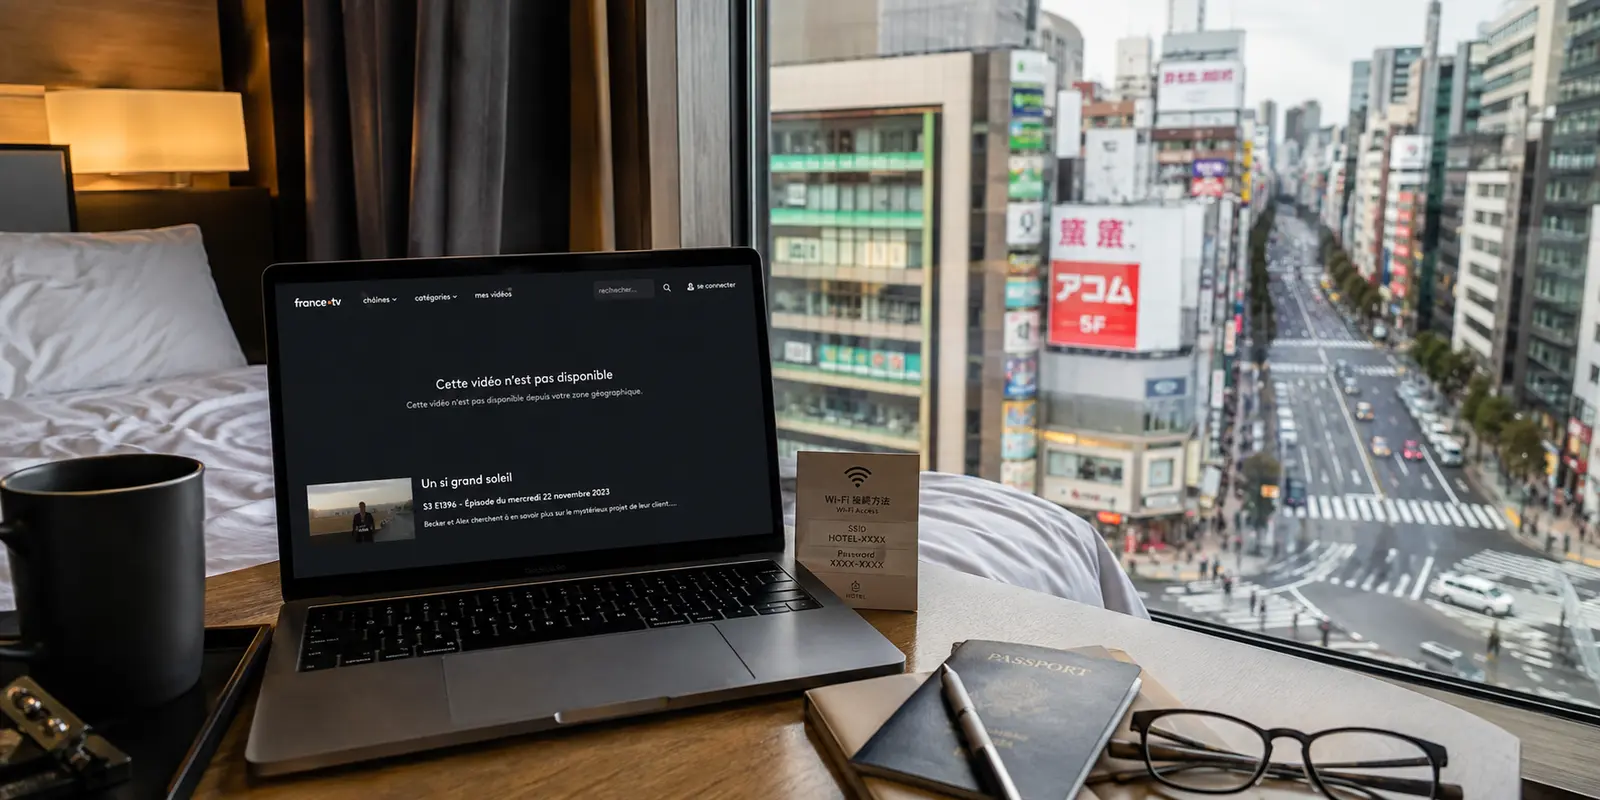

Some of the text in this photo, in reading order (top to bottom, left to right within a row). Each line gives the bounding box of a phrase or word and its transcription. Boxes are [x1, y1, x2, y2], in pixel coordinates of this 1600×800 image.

[1056, 273, 1134, 305] アコム
[1080, 314, 1106, 333] 5F
[436, 369, 613, 390] Cette vidéo n'est pas disponible
[406, 401, 428, 409] Cette
[471, 398, 485, 406] pas
[486, 394, 524, 405] disponible
[526, 392, 550, 402] depuis
[590, 388, 643, 400] géographique.
[421, 472, 512, 489] Un si grand soleil
[422, 502, 433, 510] S3
[434, 501, 457, 510] E1396
[464, 498, 494, 508] Épisode
[496, 496, 506, 504] du
[508, 494, 541, 503] mercredi
[543, 492, 552, 500] 22
[554, 490, 591, 500] novembre
[592, 488, 610, 496] 2023
[824, 495, 850, 504] Wi-Fi
[470, 515, 503, 524] cherchent
[520, 512, 539, 520] savoir
[540, 511, 554, 519] plus
[573, 506, 608, 516] mystérieux
[609, 504, 628, 513] projet
[848, 524, 866, 533] SSID
[828, 534, 886, 544] HOTEL-XXXX
[830, 559, 884, 568] XXXX-XXXX
[988, 653, 1091, 677] PASSPORT
